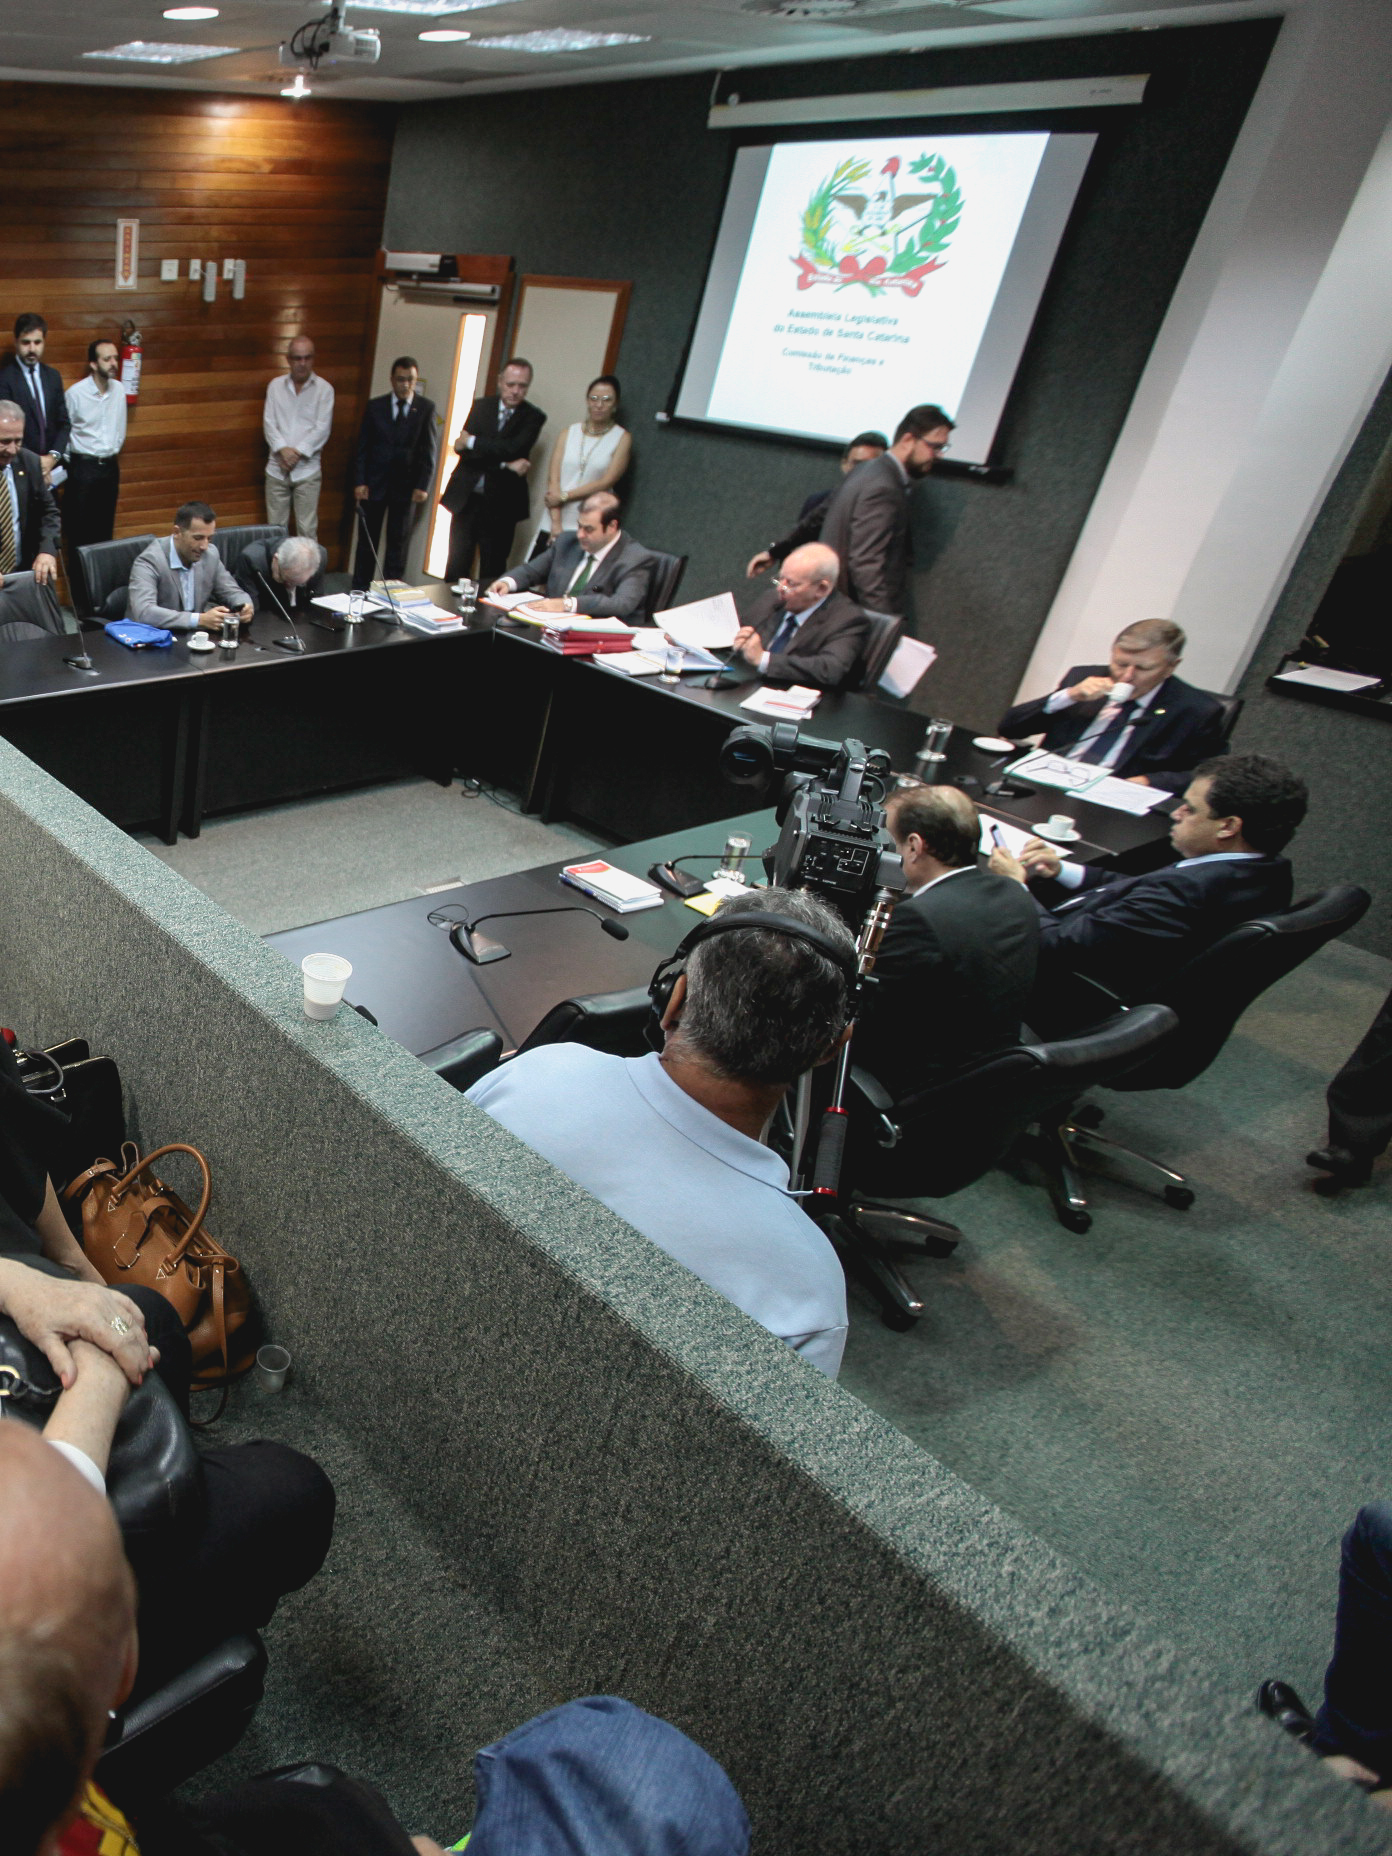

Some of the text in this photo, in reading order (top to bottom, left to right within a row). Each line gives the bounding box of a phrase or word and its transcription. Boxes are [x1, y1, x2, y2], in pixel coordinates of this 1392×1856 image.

[845, 313, 899, 325] Legislativa
[787, 324, 820, 335] Estado
[837, 328, 864, 339] Santa
[867, 331, 910, 344] Catarina
